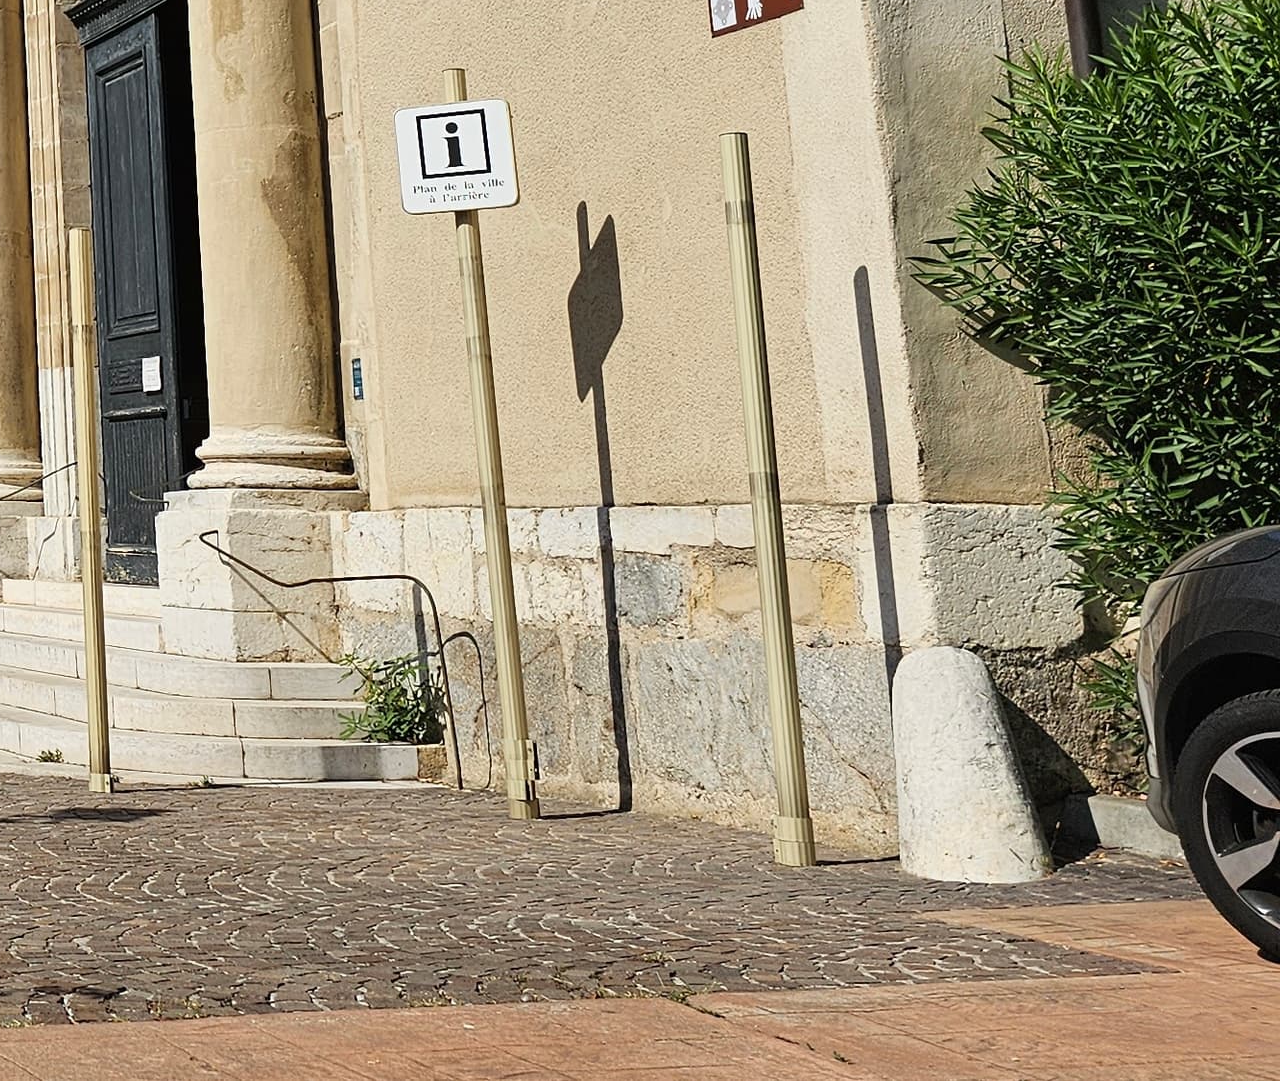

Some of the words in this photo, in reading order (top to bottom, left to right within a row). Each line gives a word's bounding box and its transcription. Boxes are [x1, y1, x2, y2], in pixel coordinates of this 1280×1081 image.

[413, 185, 437, 195] Plan
[444, 182, 457, 192] de
[464, 181, 474, 190] la
[482, 178, 505, 188] ville
